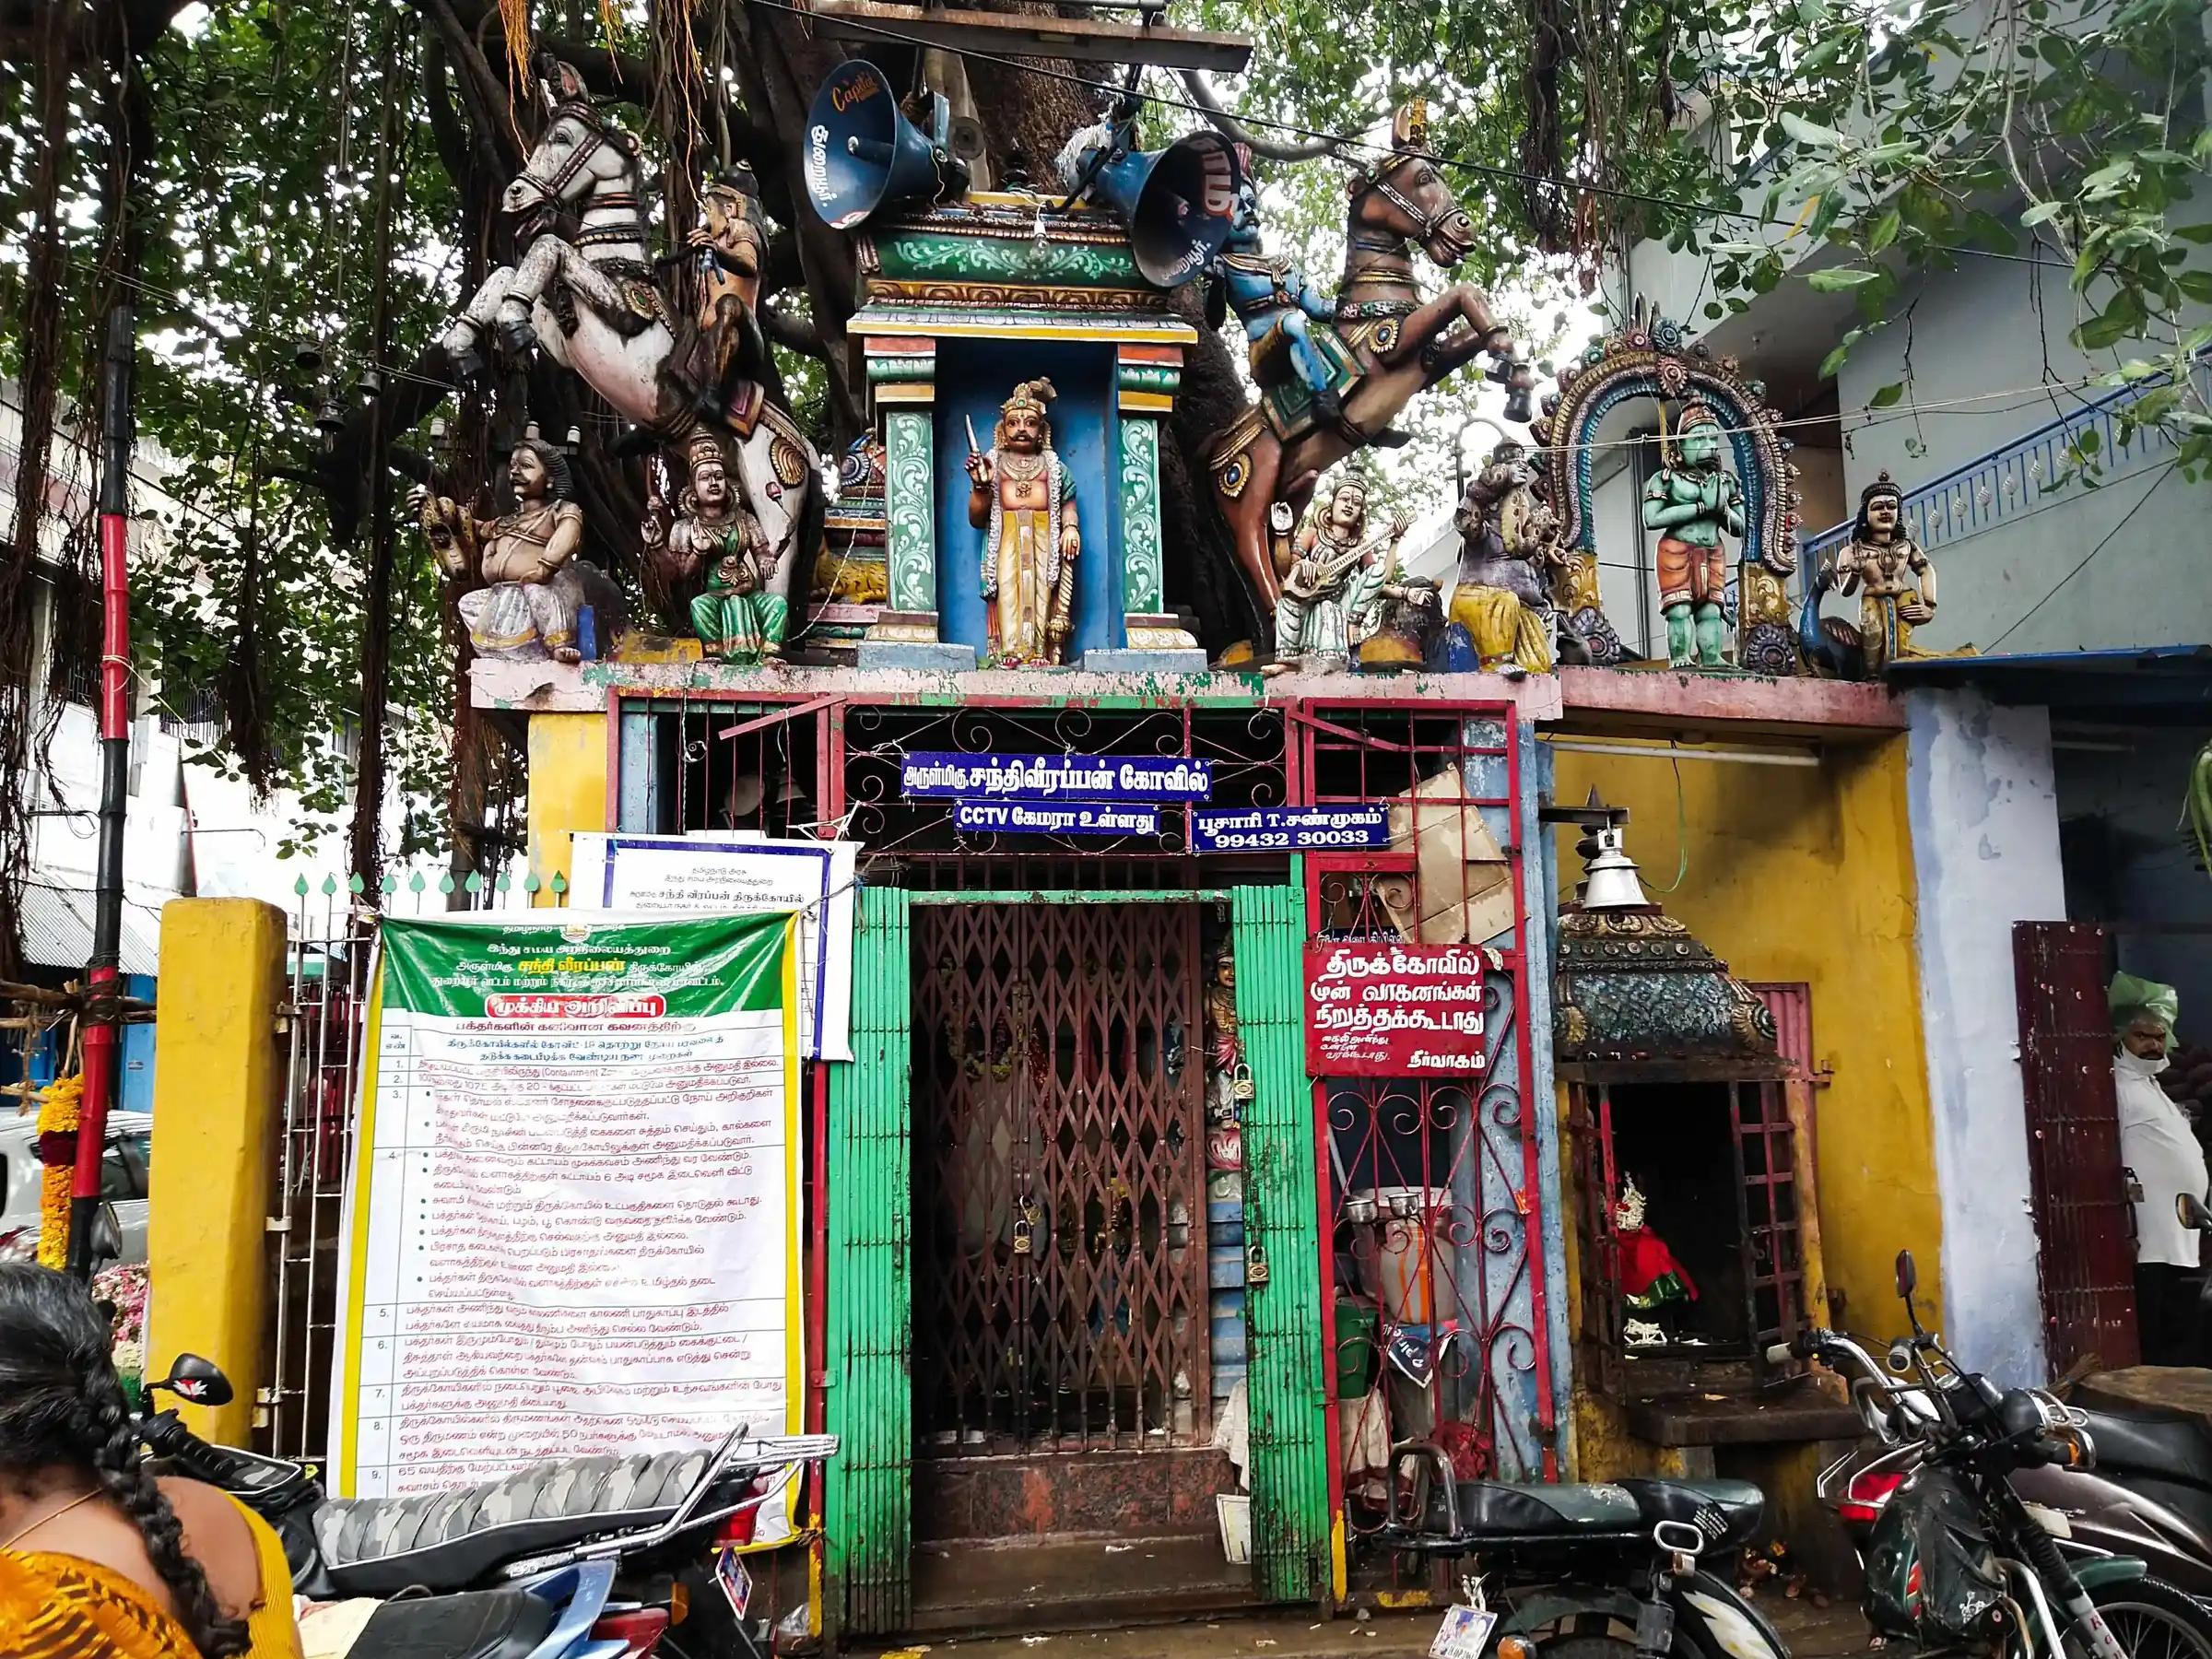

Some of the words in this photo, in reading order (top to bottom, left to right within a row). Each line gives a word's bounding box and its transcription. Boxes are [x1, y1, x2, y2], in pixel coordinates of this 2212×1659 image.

[1120, 760, 1208, 792] கோவில்
[960, 806, 1008, 825] CCTV
[1011, 807, 1075, 827] கேமரா
[1080, 806, 1154, 833] உள்ளது
[1198, 811, 1262, 831] பூசாரி
[1266, 806, 1382, 829] T.சண்முகம்
[1215, 831, 1288, 848] 99432
[1297, 830, 1369, 846] 30033
[658, 888, 685, 900] சந்தி
[687, 888, 731, 901] வீரப்பன்
[733, 889, 805, 904] திருக்கோயில்
[487, 943, 521, 956] இந்து
[524, 946, 553, 955] சமய
[456, 960, 512, 973] அருள்மிகு
[517, 955, 555, 974] சந்தி
[558, 954, 626, 974] வீரப்பன்
[1318, 946, 1480, 982] திருக்கோவில்
[1310, 980, 1351, 1003] முன்
[1362, 980, 1482, 1004] வாகனங்கள்
[495, 995, 559, 1015] முக்கிய
[561, 995, 656, 1017] அறிவிப்பு
[455, 1020, 534, 1031] பக்தர்களின்
[1313, 1003, 1484, 1035] நிறுத்தக்கூடாது
[396, 1060, 404, 1069] 1.
[394, 1075, 403, 1084] 2.
[393, 1090, 402, 1099] 3.
[682, 1091, 712, 1105] நோய்
[715, 1088, 773, 1102] அறிகுறிகள்
[638, 1124, 671, 1138] சுத்தம்
[722, 1118, 771, 1132] கால்களை
[632, 1153, 681, 1167] அணிந்து
[683, 1156, 698, 1164] வர
[700, 1150, 752, 1163] வேண்டும்.
[604, 1172, 612, 1182] 6
[615, 1171, 634, 1183] அடி
[636, 1171, 665, 1182] சமூக
[667, 1168, 724, 1181] இடைவெளி
[726, 1165, 753, 1177] விட்டு
[497, 1200, 533, 1212] மற்றும்
[677, 1197, 724, 1211] தொடுதல்
[726, 1194, 763, 1206] கூடாது.
[555, 1215, 602, 1227] கொண்டு
[694, 1210, 747, 1224] வேண்டும்.
[639, 1243, 704, 1258] திருக்கோயில்
[429, 1272, 477, 1286] பக்தர்கள்
[380, 1308, 390, 1318] 5.
[406, 1303, 453, 1317] பக்தர்கள்
[456, 1301, 504, 1315] அணிந்து
[589, 1307, 630, 1319] காலணி
[632, 1307, 684, 1321] பாதுகாப்பு
[686, 1303, 729, 1318] இடத்தில்
[566, 1324, 610, 1336] அணிந்து
[612, 1323, 647, 1334] செல்ல
[648, 1320, 703, 1334] வேண்டும்.
[377, 1340, 388, 1350] 6.
[404, 1335, 453, 1348] பக்தர்கள்
[606, 1337, 677, 1351] பயன்படுத்தும்
[678, 1335, 741, 1348] கைக்குட்டை
[677, 1352, 712, 1365] எடுத்து
[713, 1349, 752, 1362] சென்று
[375, 1388, 385, 1398] 7.
[633, 1383, 670, 1397] மற்றும்
[752, 1380, 782, 1393] போது
[373, 1420, 383, 1430] 8.
[399, 1434, 420, 1445] ஒரு
[478, 1430, 506, 1442] என்ற
[561, 1429, 578, 1441] 50
[398, 1466, 417, 1477] 65
